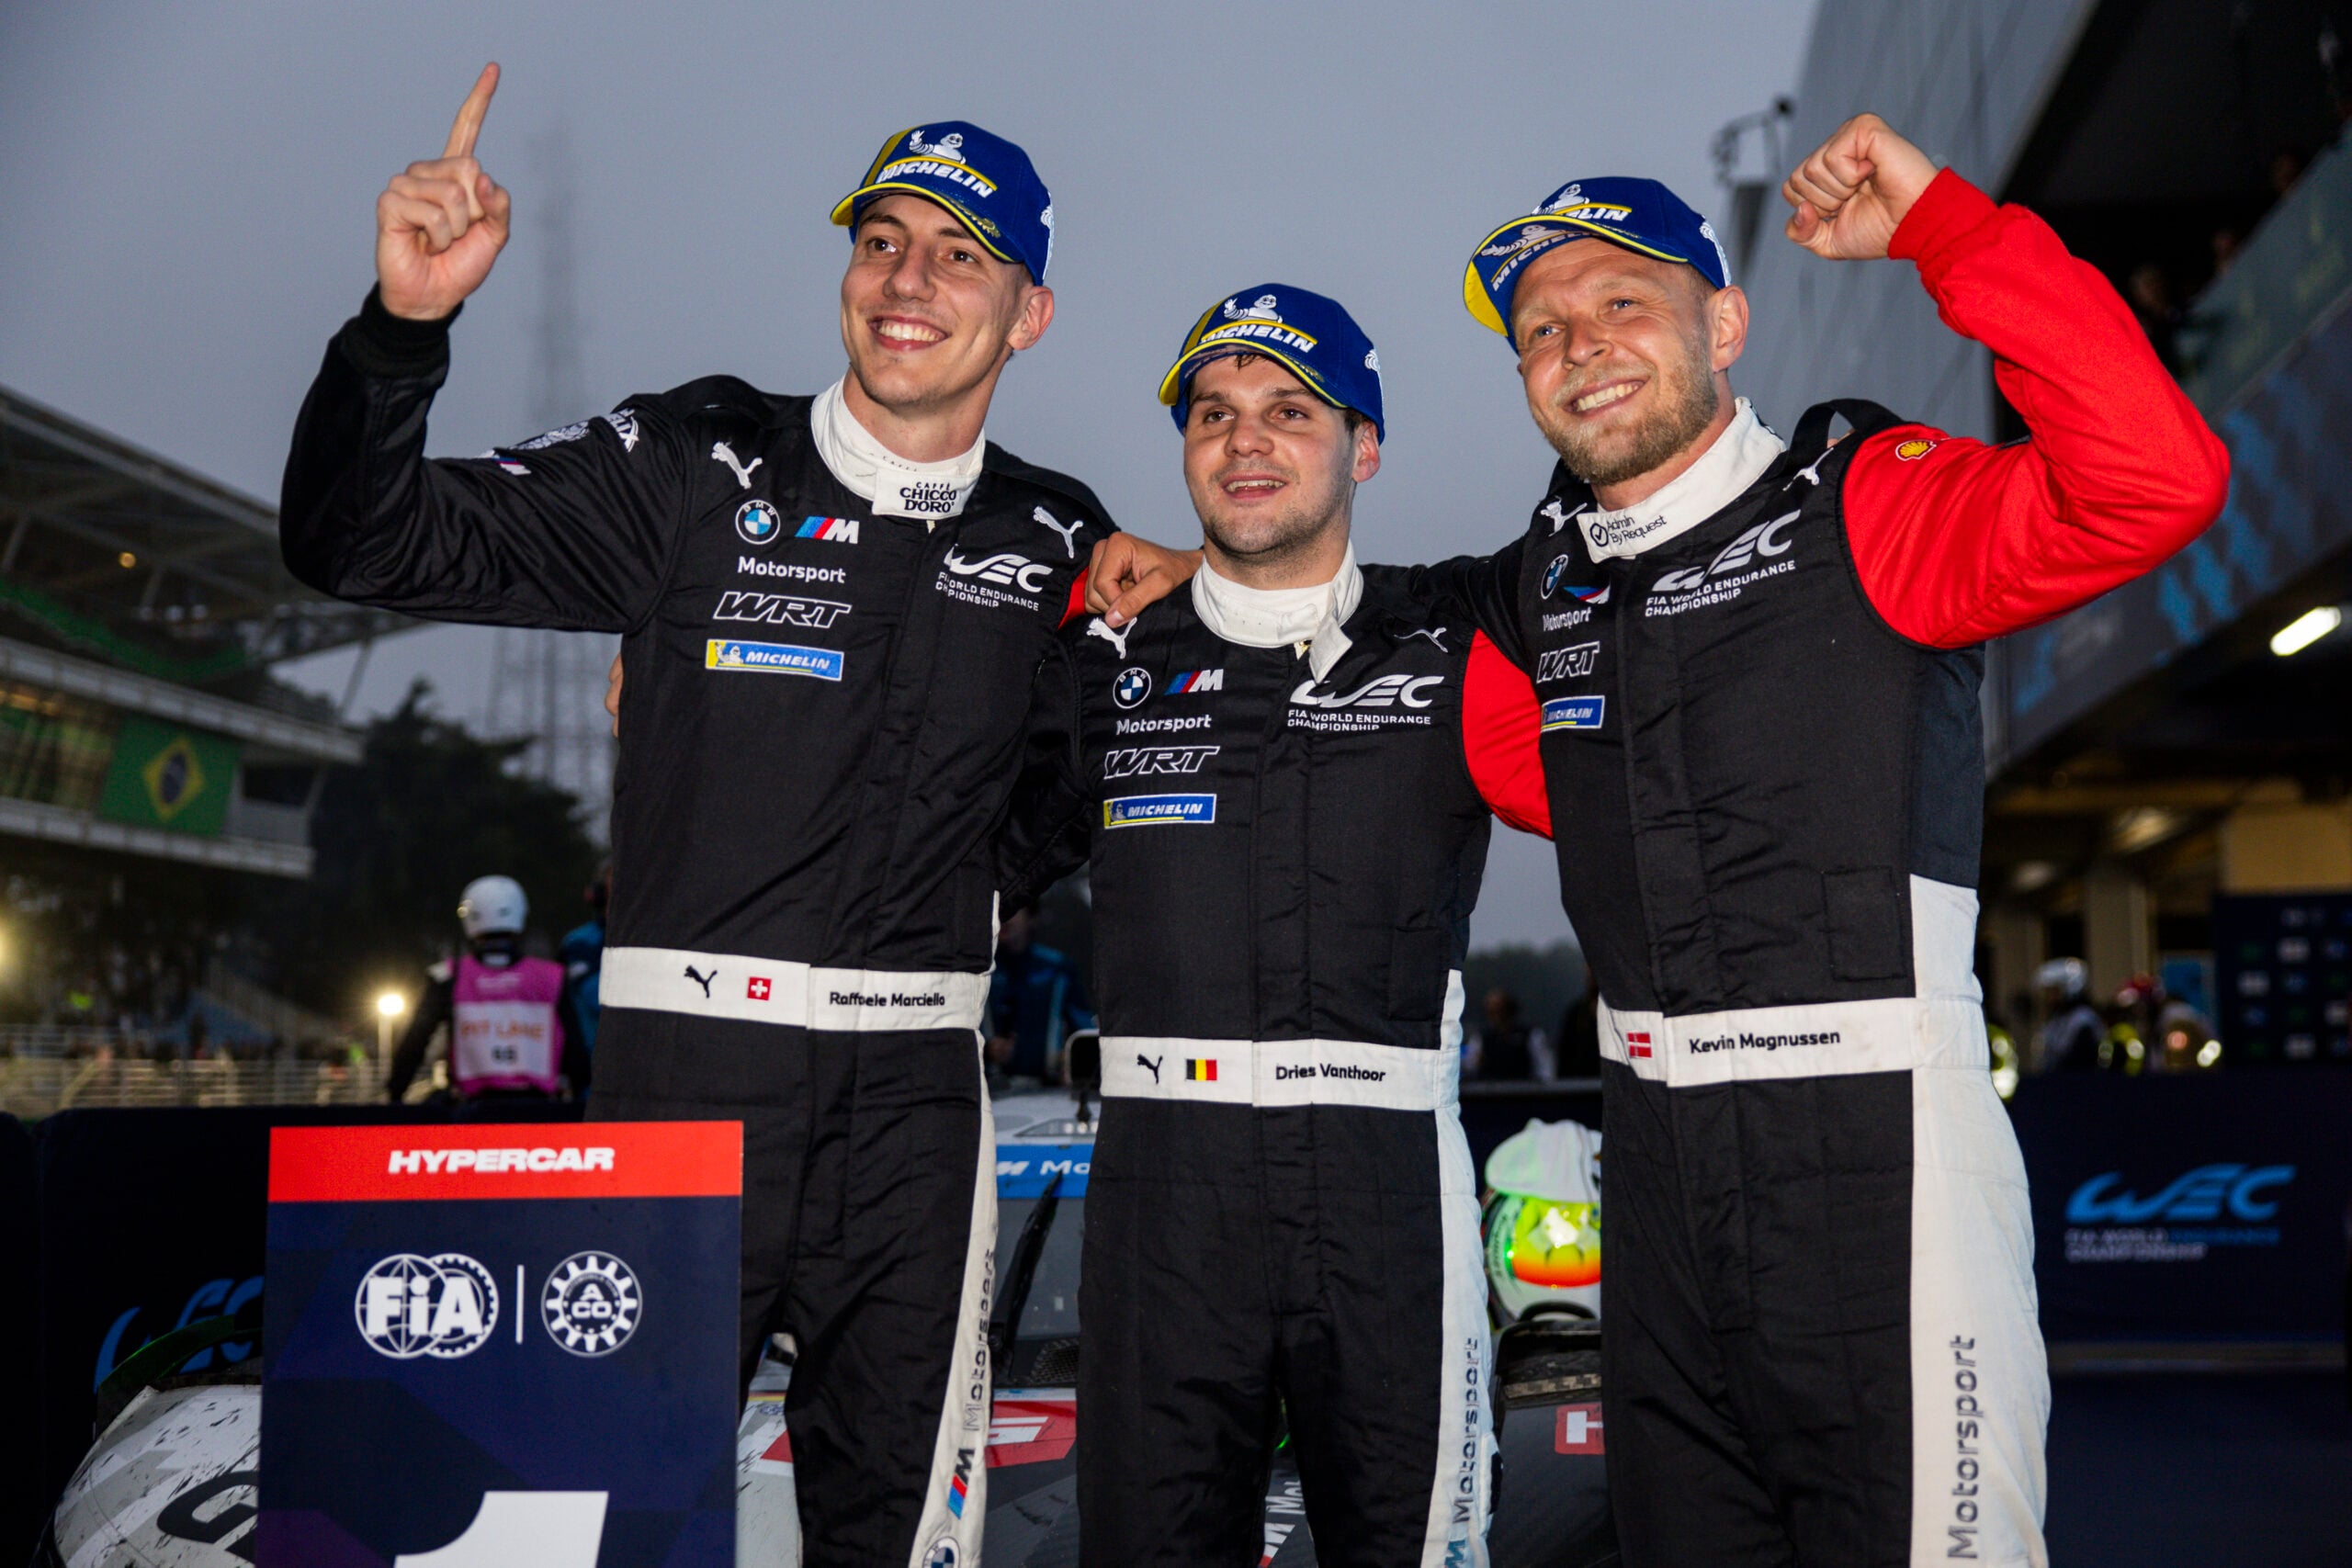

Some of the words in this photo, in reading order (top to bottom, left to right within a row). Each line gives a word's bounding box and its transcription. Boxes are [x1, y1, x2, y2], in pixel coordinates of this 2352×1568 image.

[876, 161, 994, 198] MICHELIN
[899, 487, 957, 502] CHICCO
[1610, 533, 1623, 545] By
[1622, 515, 1667, 540] Request
[1651, 509, 1802, 592] WEC
[738, 556, 846, 583] Motorsport
[944, 543, 1054, 592] WEC
[1646, 597, 1668, 606] FIA
[1715, 560, 1796, 591] ENDURANCE
[713, 591, 853, 629] WRT
[979, 587, 1040, 612] ENDURANCE
[1645, 588, 1742, 617] CHAMPIONSHIP
[1543, 607, 1591, 632] Motorsport
[746, 651, 831, 670] MICHELIN
[1536, 640, 1600, 684] WRT
[1290, 674, 1445, 708] WEC
[1115, 715, 1212, 736] Motorsport
[1287, 718, 1380, 731] CHAMPIONSHIP
[1288, 709, 1307, 718] FIA
[1310, 711, 1352, 723] WORLD
[1356, 714, 1431, 725] ENDURANCE
[1103, 746, 1221, 780] WRT
[1127, 804, 1204, 818] MICHELIN
[830, 991, 887, 1007] Raffaele
[890, 993, 945, 1007] Marciello
[1689, 1035, 1735, 1054] Kevin
[1739, 1032, 1840, 1051] Magnussen
[1276, 1065, 1317, 1080] Dries
[1319, 1063, 1386, 1082] Vanthoor
[388, 1147, 616, 1174] HYPERCAR
[1947, 1335, 1984, 1560] Motorsport
